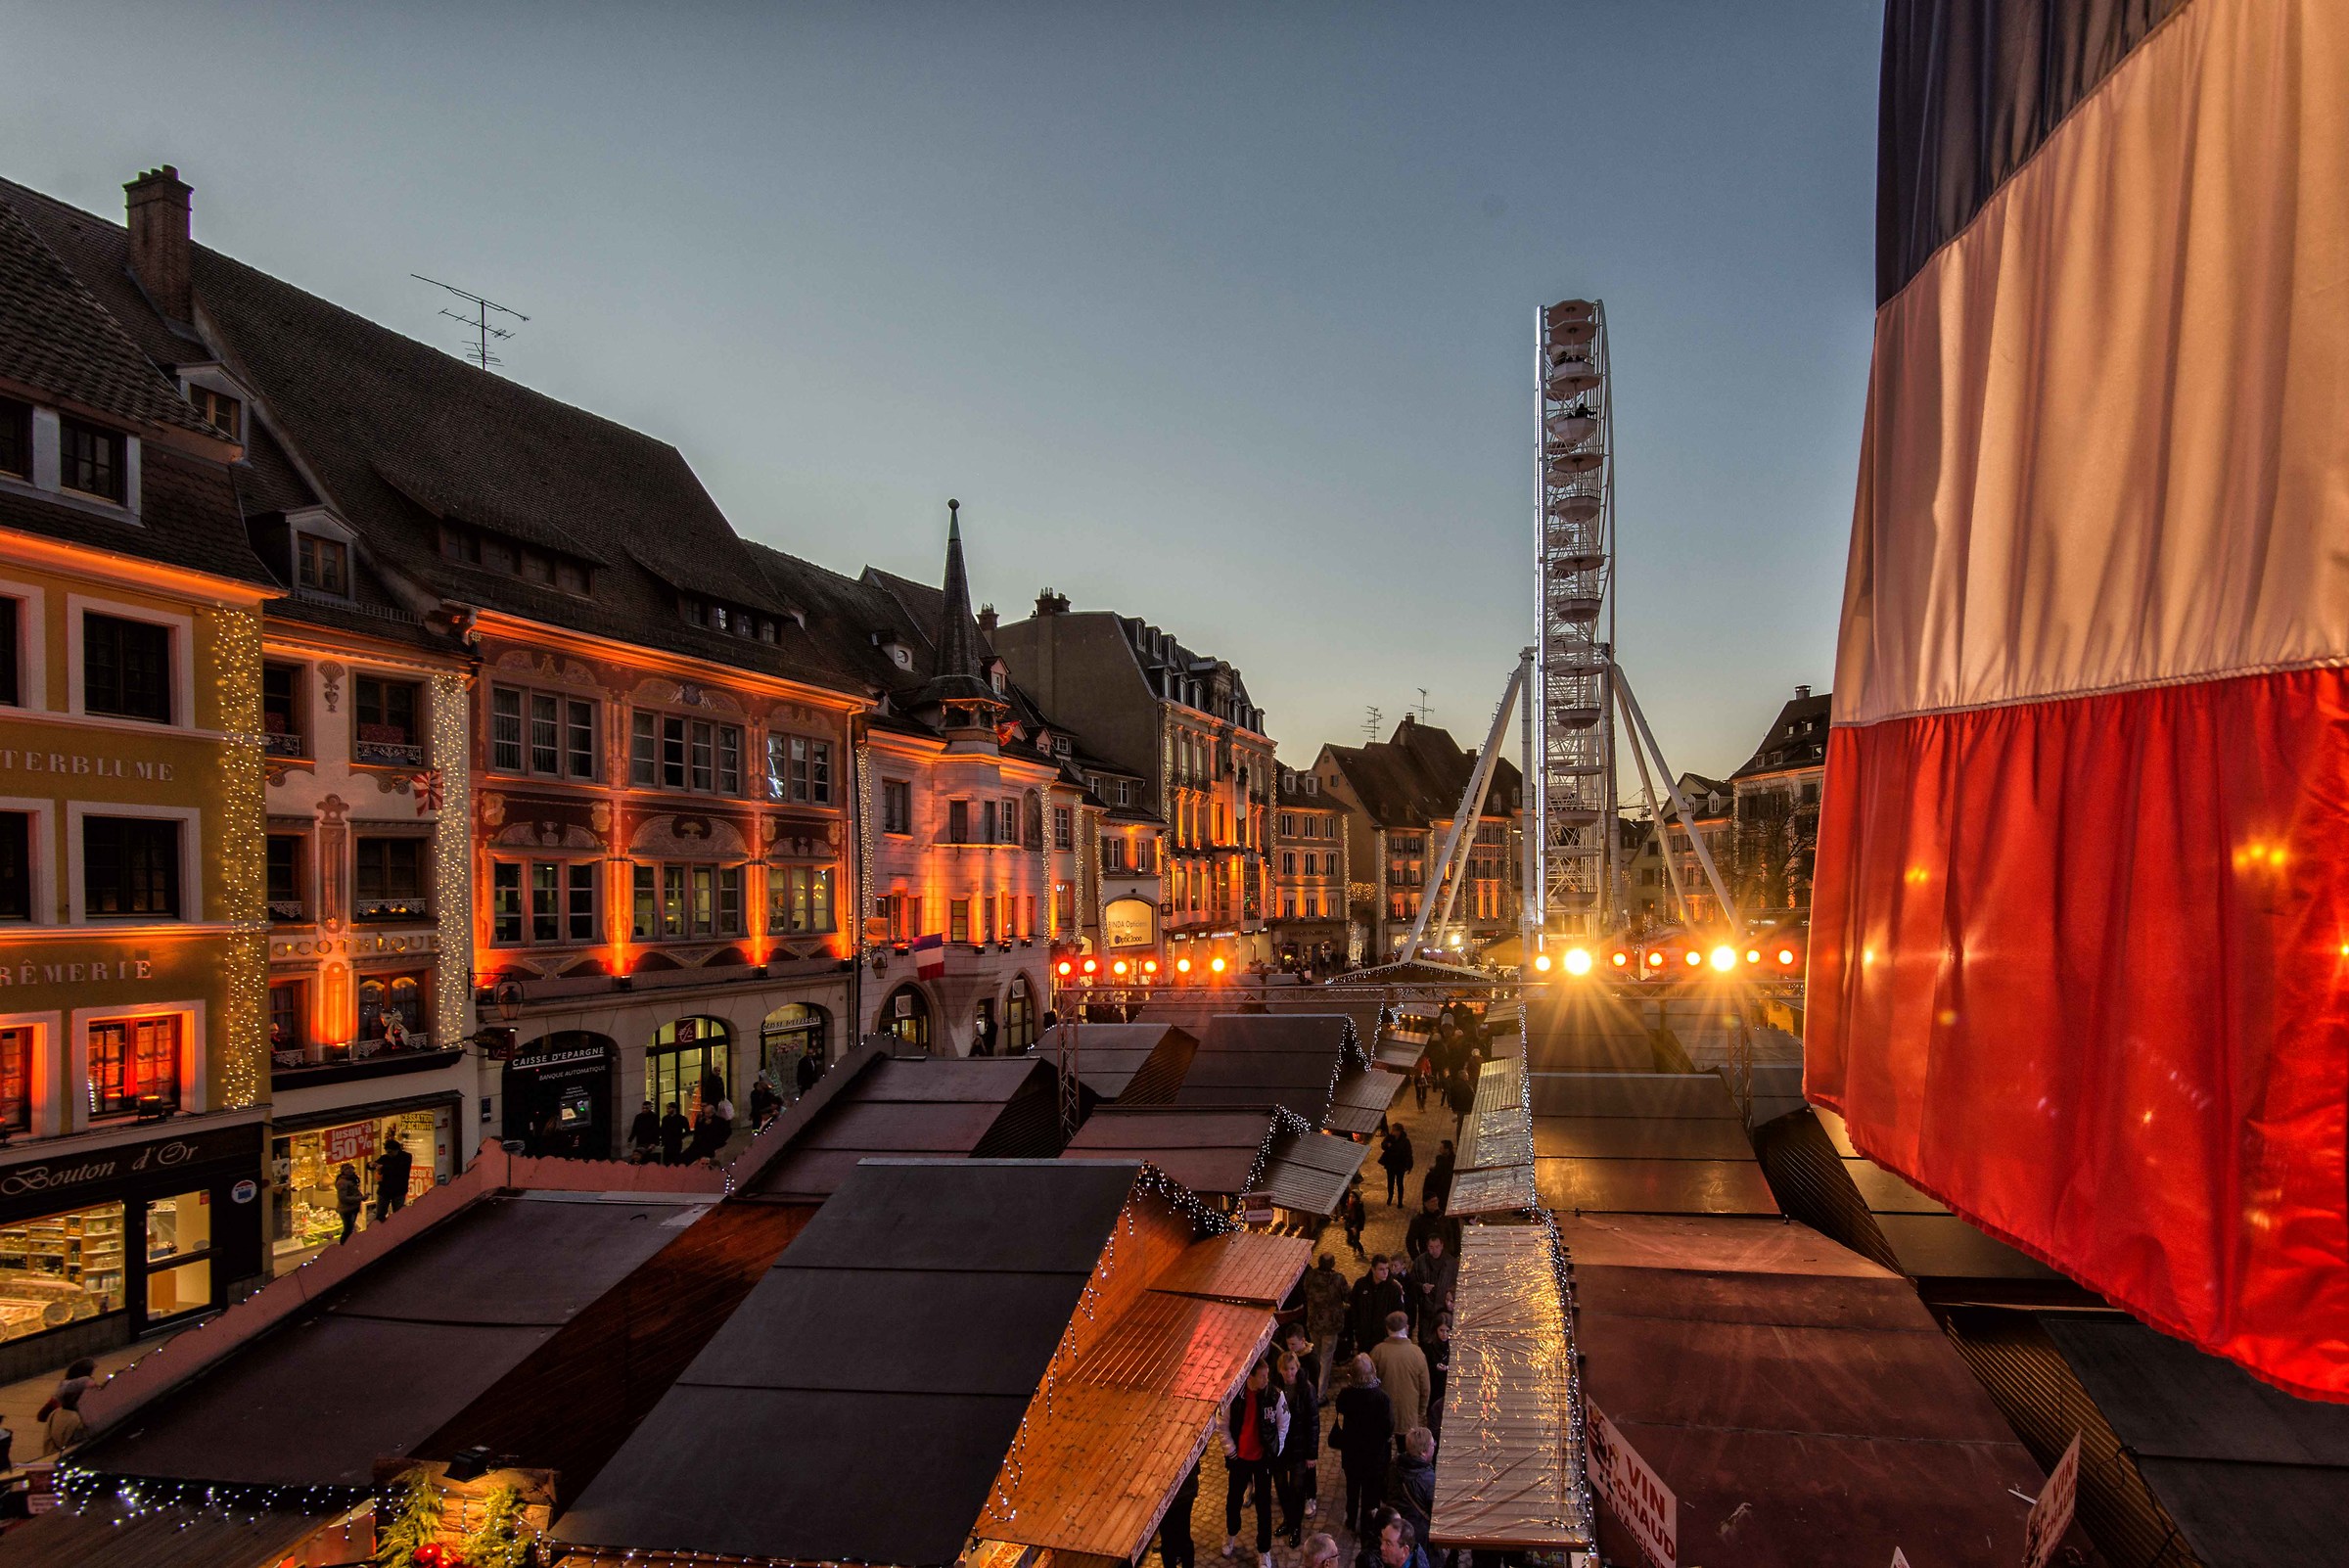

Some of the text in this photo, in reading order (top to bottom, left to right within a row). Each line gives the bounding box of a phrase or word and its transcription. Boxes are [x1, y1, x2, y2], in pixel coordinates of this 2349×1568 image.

[0, 750, 173, 781] TERBLUME
[0, 958, 153, 987] RÊMERIE
[512, 1046, 605, 1067] CAISSE D'EPARGNE
[539, 1065, 606, 1082] BANQUE AUTOMATIQUE
[400, 1113, 434, 1123] CESSATION
[2, 1141, 198, 1195] Bouton d'Or
[1626, 1453, 1665, 1524] VIN
[2052, 1453, 2074, 1504] VIN
[1605, 1491, 1613, 1506] A
[1617, 1476, 1676, 1562] CHAUD
